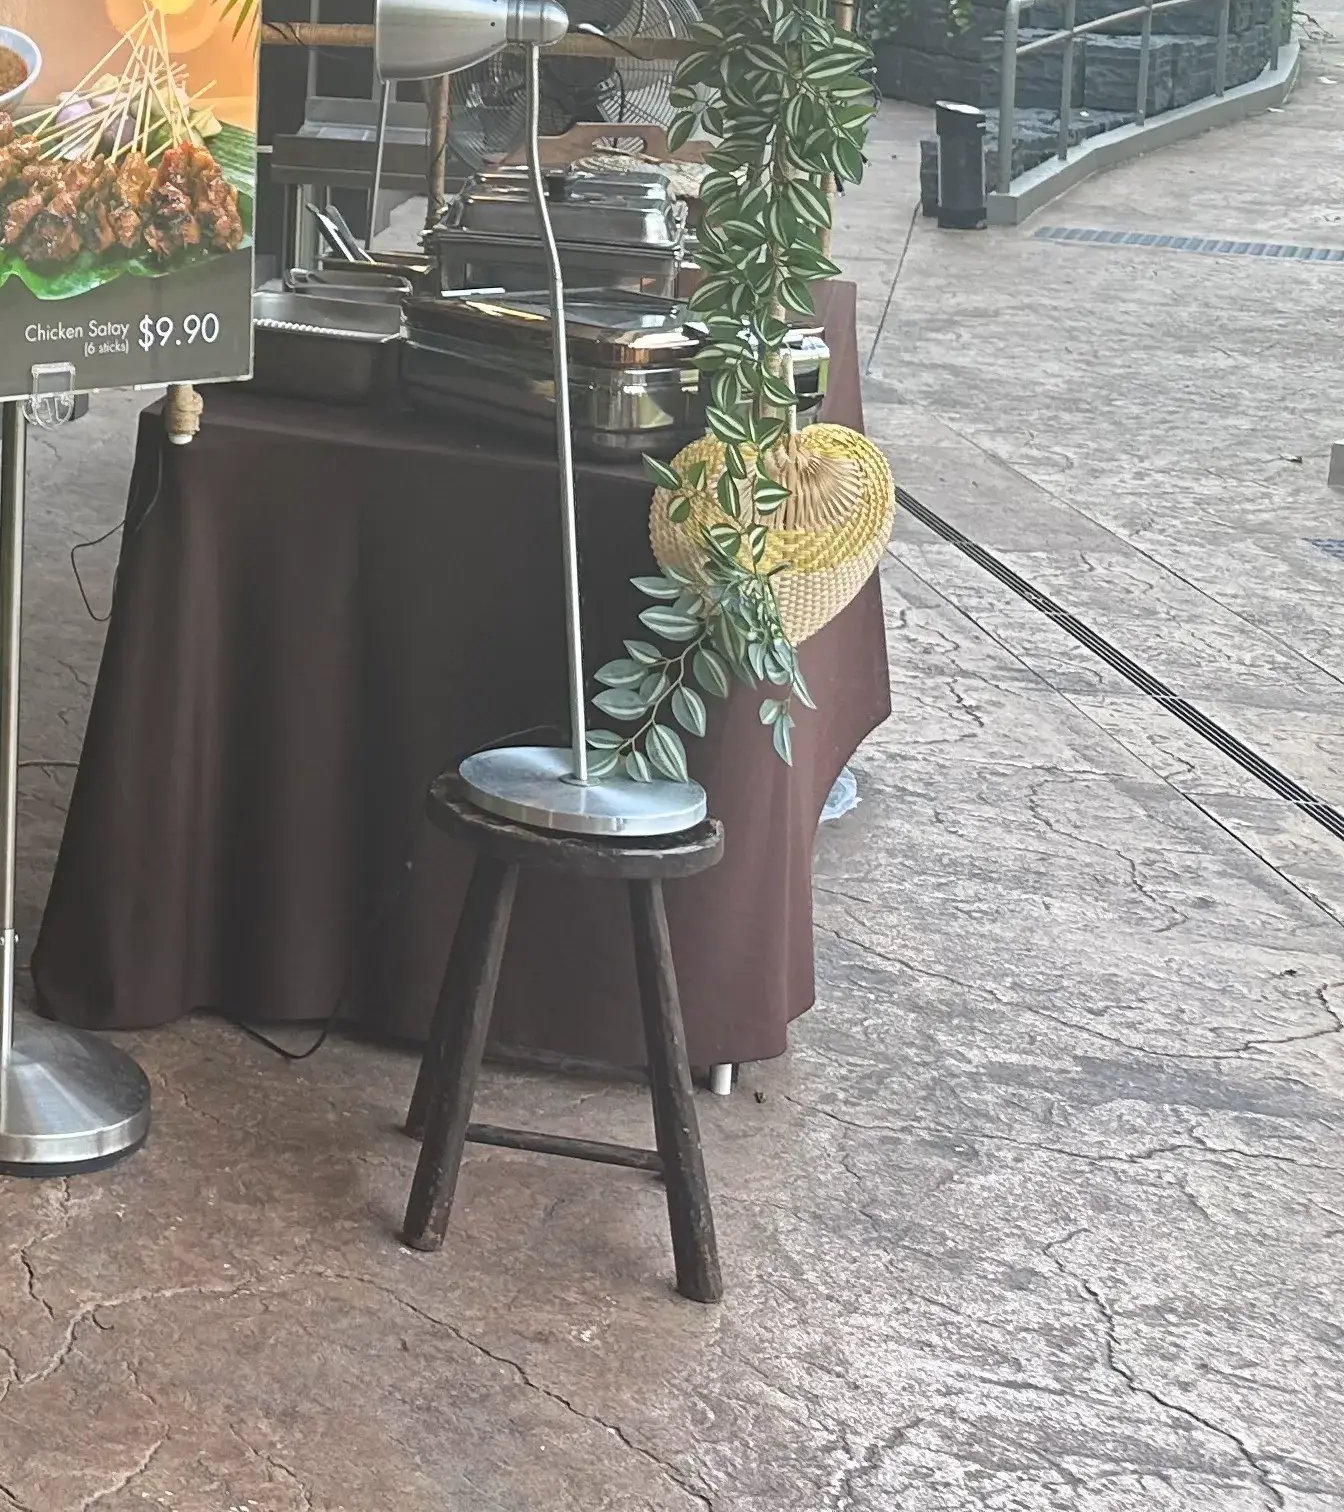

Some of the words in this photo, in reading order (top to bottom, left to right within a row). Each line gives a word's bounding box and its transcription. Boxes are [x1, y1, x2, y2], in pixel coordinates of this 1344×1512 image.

[24, 322, 84, 342] Chicken
[88, 319, 130, 339] Satay
[138, 312, 220, 352] $9.90
